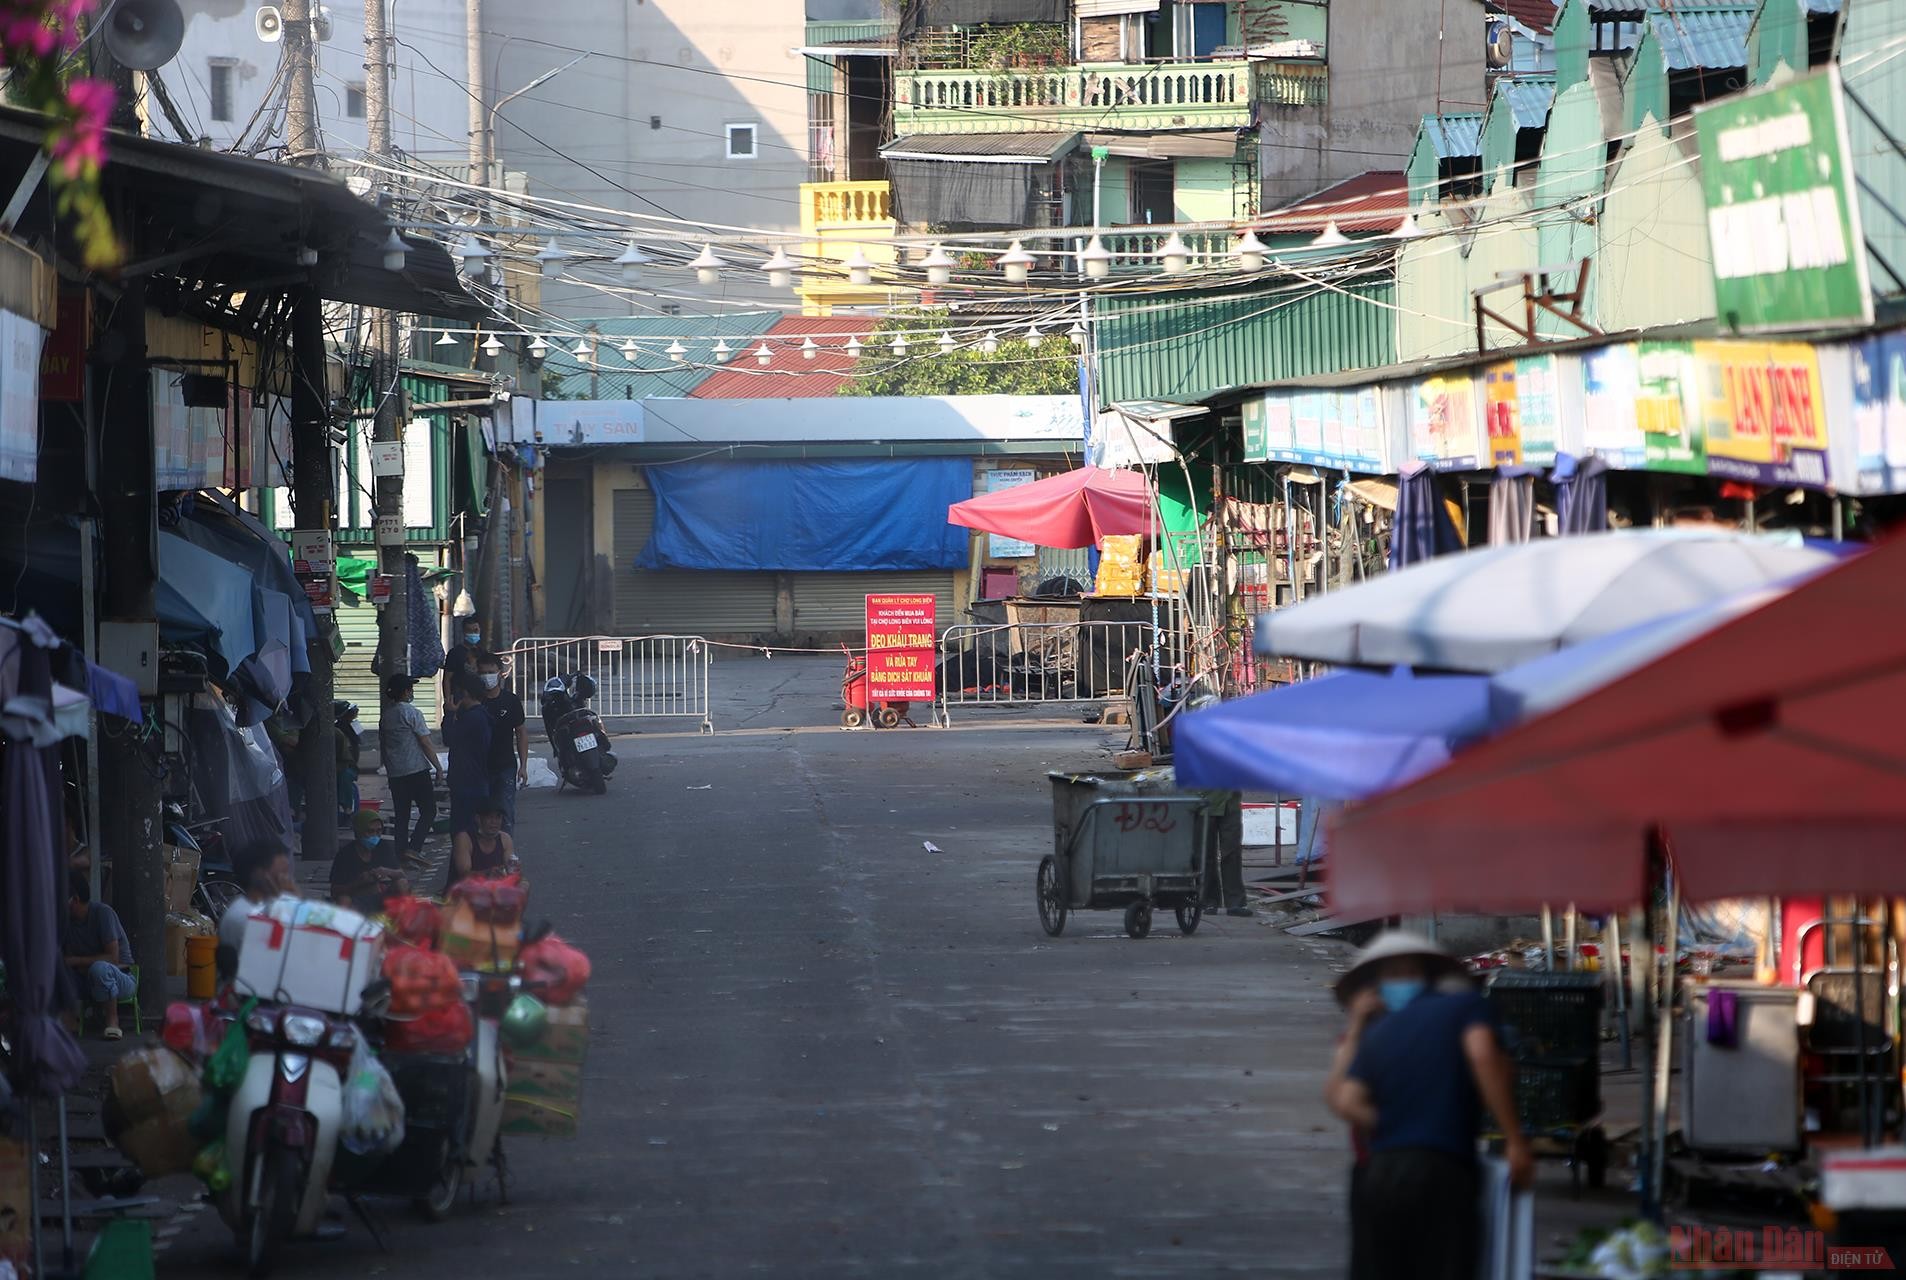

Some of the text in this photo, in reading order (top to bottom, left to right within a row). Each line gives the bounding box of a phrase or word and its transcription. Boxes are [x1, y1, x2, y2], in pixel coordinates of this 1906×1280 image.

[1724, 365, 1767, 433] LAN
[871, 626, 932, 648] ĐEO KHẨU TRANG
[885, 653, 918, 667] VÀ RỬA TAY
[887, 671, 901, 685] DỊCH
[901, 669, 912, 682] SÁT
[913, 665, 932, 682] KHUẨN
